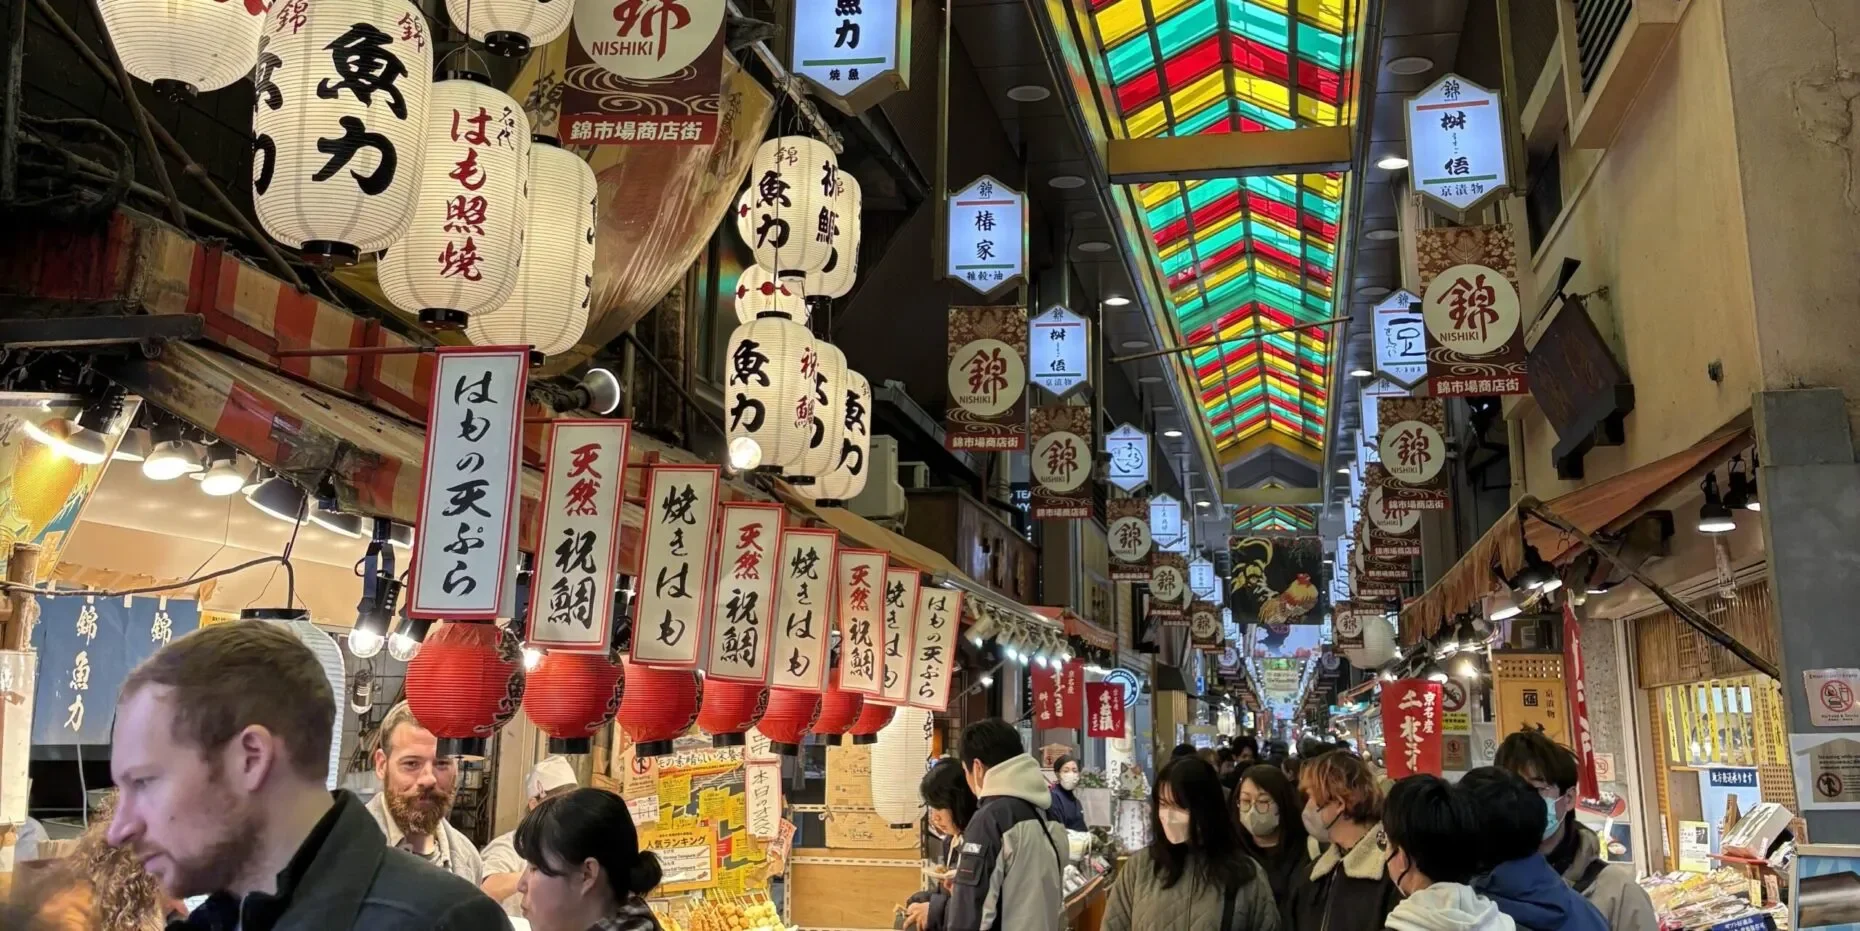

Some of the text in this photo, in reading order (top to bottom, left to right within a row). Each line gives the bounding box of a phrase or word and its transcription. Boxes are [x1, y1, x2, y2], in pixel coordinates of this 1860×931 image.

[591, 41, 653, 56] NISHIKI
[311, 22, 409, 196] 魚力
[1441, 80, 1461, 100] 錦
[569, 121, 703, 141] 錦市場商店街
[773, 146, 799, 166] 錦
[438, 106, 492, 282] はも照焼
[756, 170, 792, 249] 魚力
[977, 181, 993, 199] 錦
[1441, 184, 1484, 197] 京漬物
[975, 210, 996, 261] 椿家
[1436, 273, 1500, 344] 錦
[1439, 331, 1479, 342] NISHIKI
[730, 338, 770, 433] 魚力
[960, 347, 1009, 406] 錦
[1436, 377, 1520, 395] 錦市場商店街
[959, 396, 991, 405] NISHIKI
[952, 436, 1019, 448] 錦市場商店街
[1040, 437, 1079, 485] 錦
[1389, 427, 1431, 475] 錦
[442, 370, 498, 598] はもの天ぷら
[1388, 499, 1444, 509] 錦市場商店街
[1036, 507, 1088, 518] 錦市場商店街
[548, 442, 602, 631] 天然 祝鯛
[1114, 521, 1142, 555] 錦
[655, 482, 700, 646] 焼きはも
[1155, 569, 1177, 596] 錦
[720, 520, 764, 670] 天然 祝鯛
[785, 546, 820, 677] 焼きはも
[151, 612, 173, 648] 錦
[847, 563, 876, 683] 天然 祝鯛
[64, 605, 98, 732] 錦 魚力
[918, 594, 947, 700] はもの天ぷら
[1421, 691, 1437, 734] 京名産
[646, 835, 707, 850] 人気ランキング
